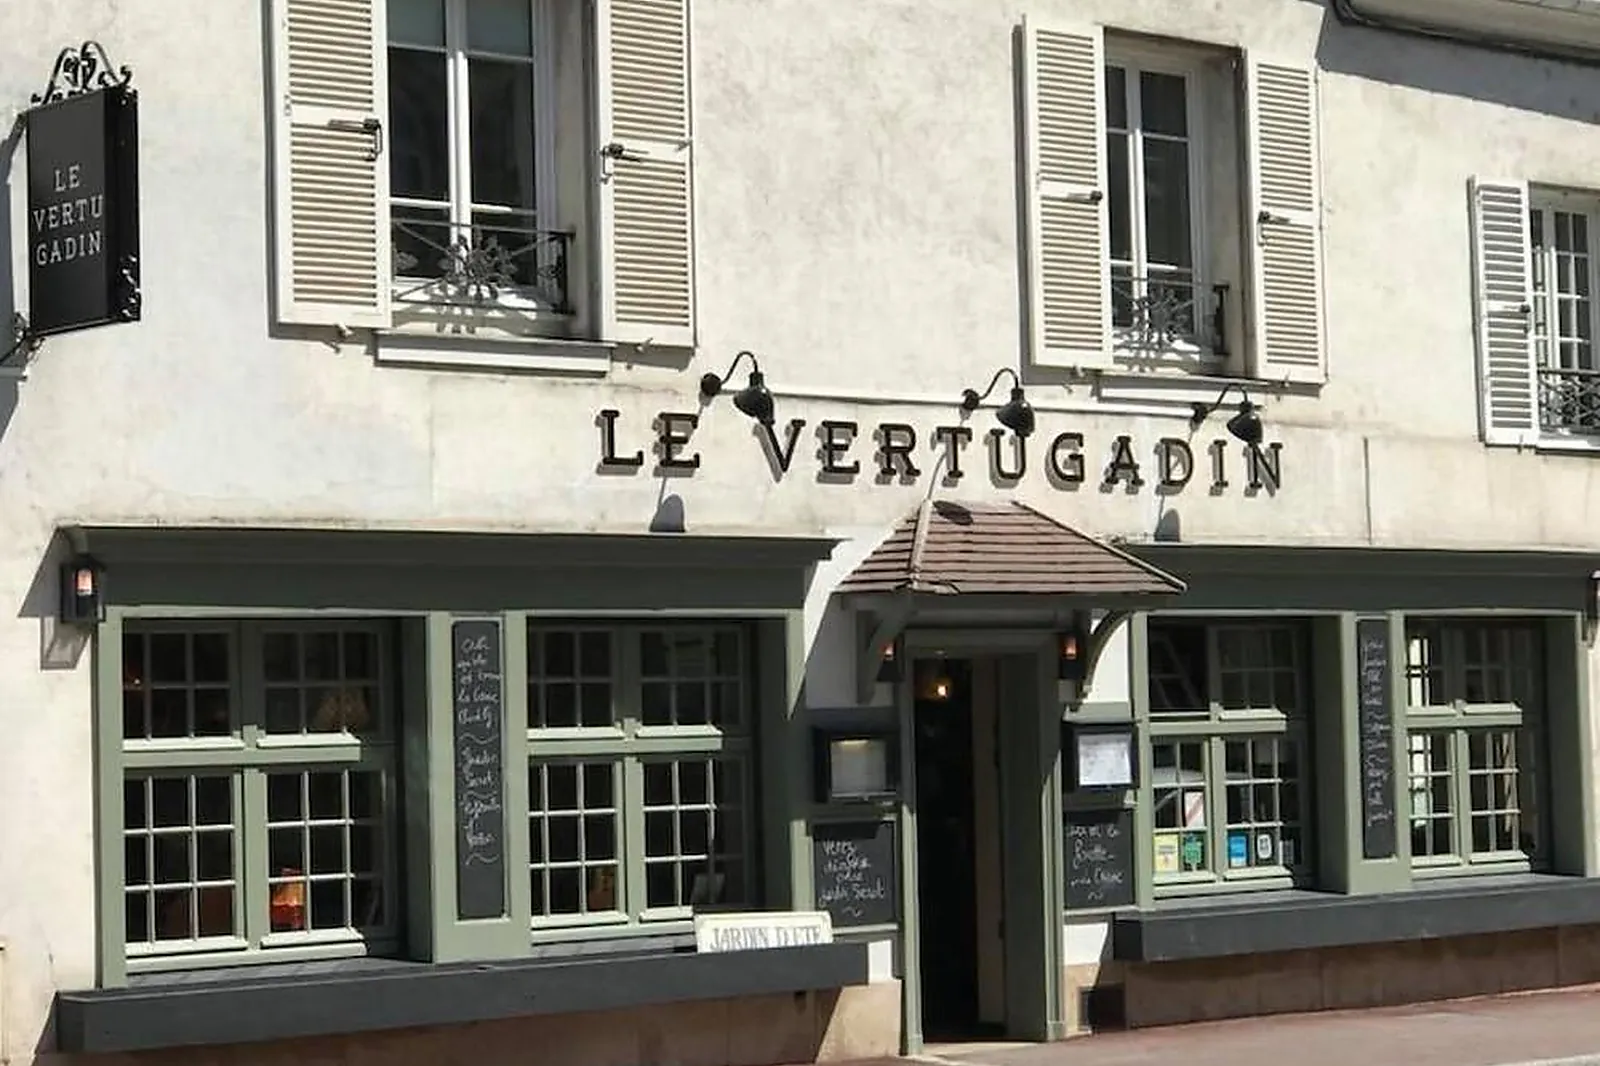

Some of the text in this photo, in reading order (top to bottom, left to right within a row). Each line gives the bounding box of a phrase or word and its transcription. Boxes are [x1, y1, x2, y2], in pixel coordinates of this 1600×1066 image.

[54, 163, 80, 192] LE
[32, 194, 104, 232] VERTU
[36, 230, 102, 266] GADIN
[597, 409, 1283, 494] LE VERTUGADIN
